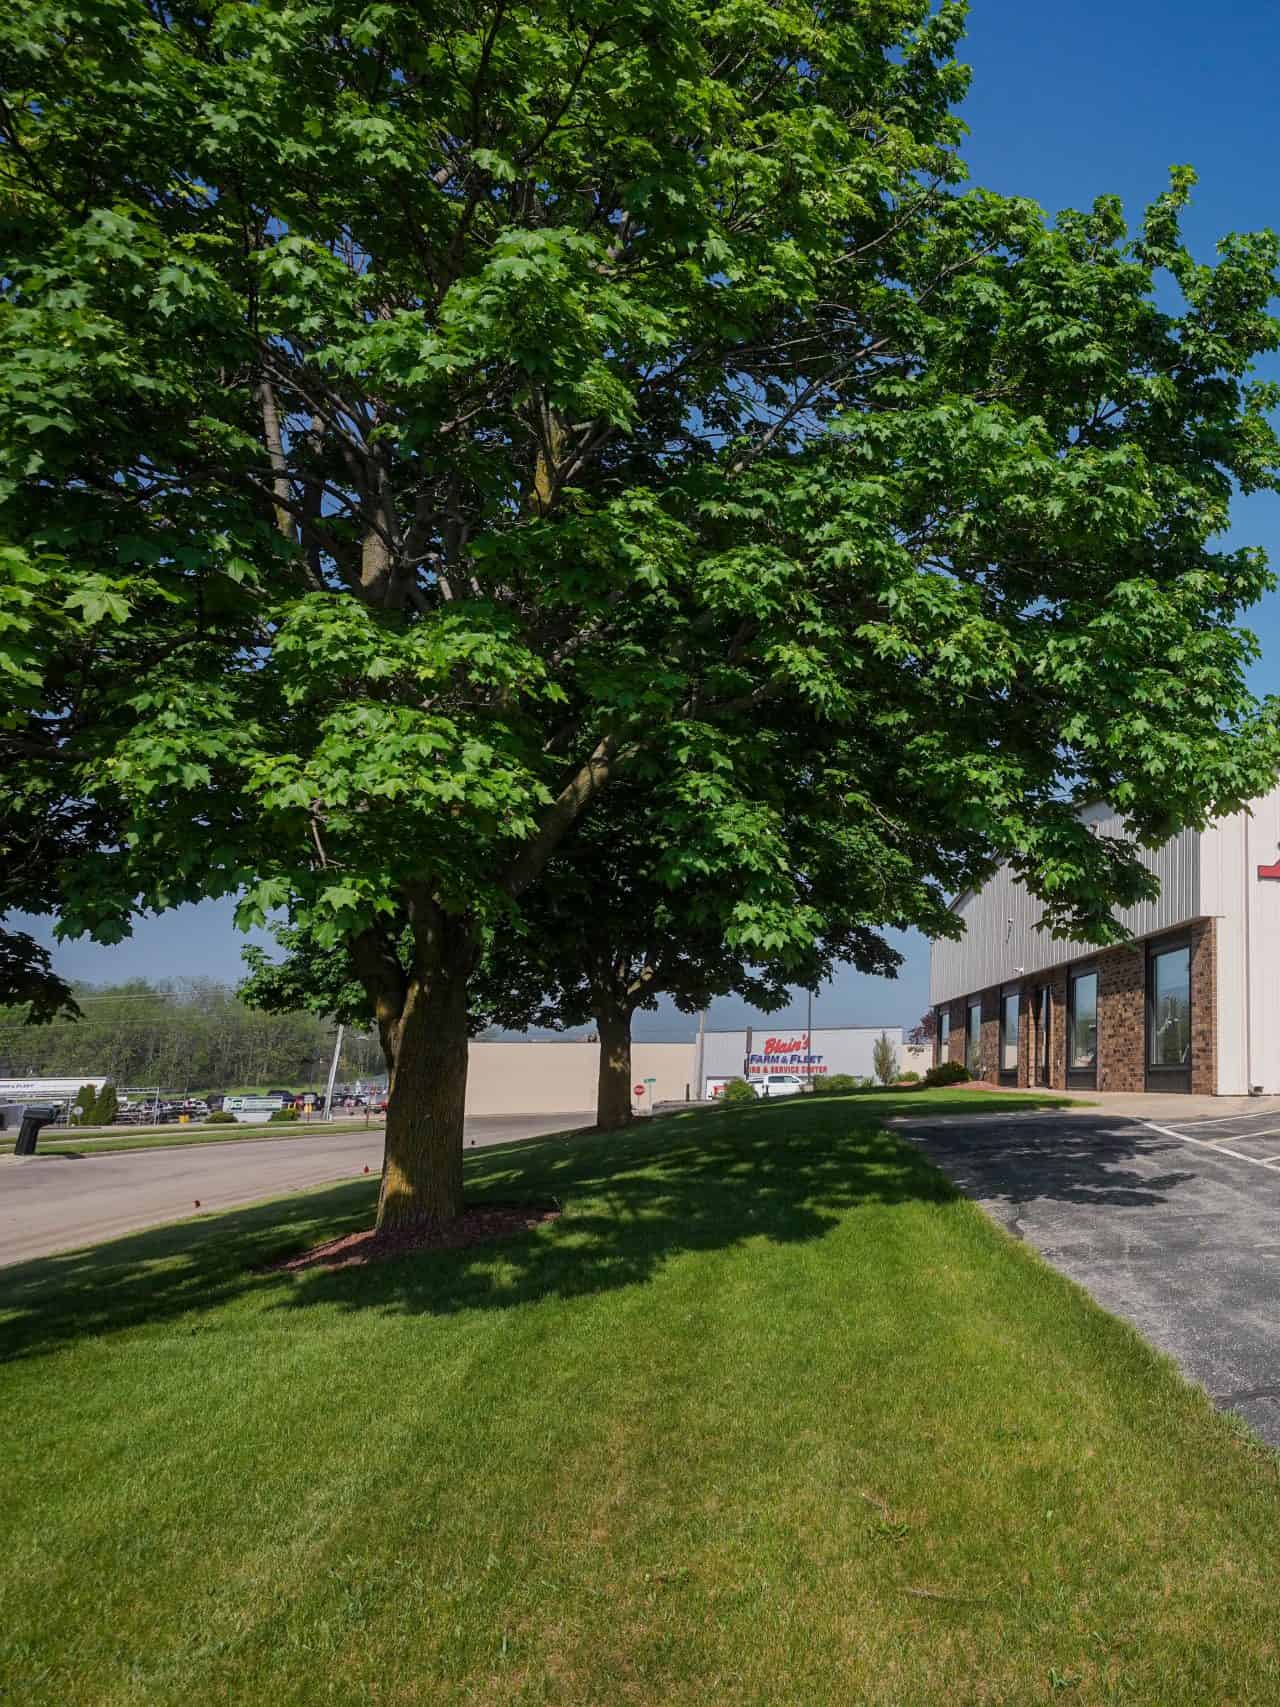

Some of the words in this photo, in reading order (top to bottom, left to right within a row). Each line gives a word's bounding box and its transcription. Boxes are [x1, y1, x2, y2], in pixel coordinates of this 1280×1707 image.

[764, 1032, 809, 1055] Blain's
[750, 1054, 780, 1065] FARM
[780, 1055, 789, 1065] &
[789, 1054, 824, 1065] FLEET
